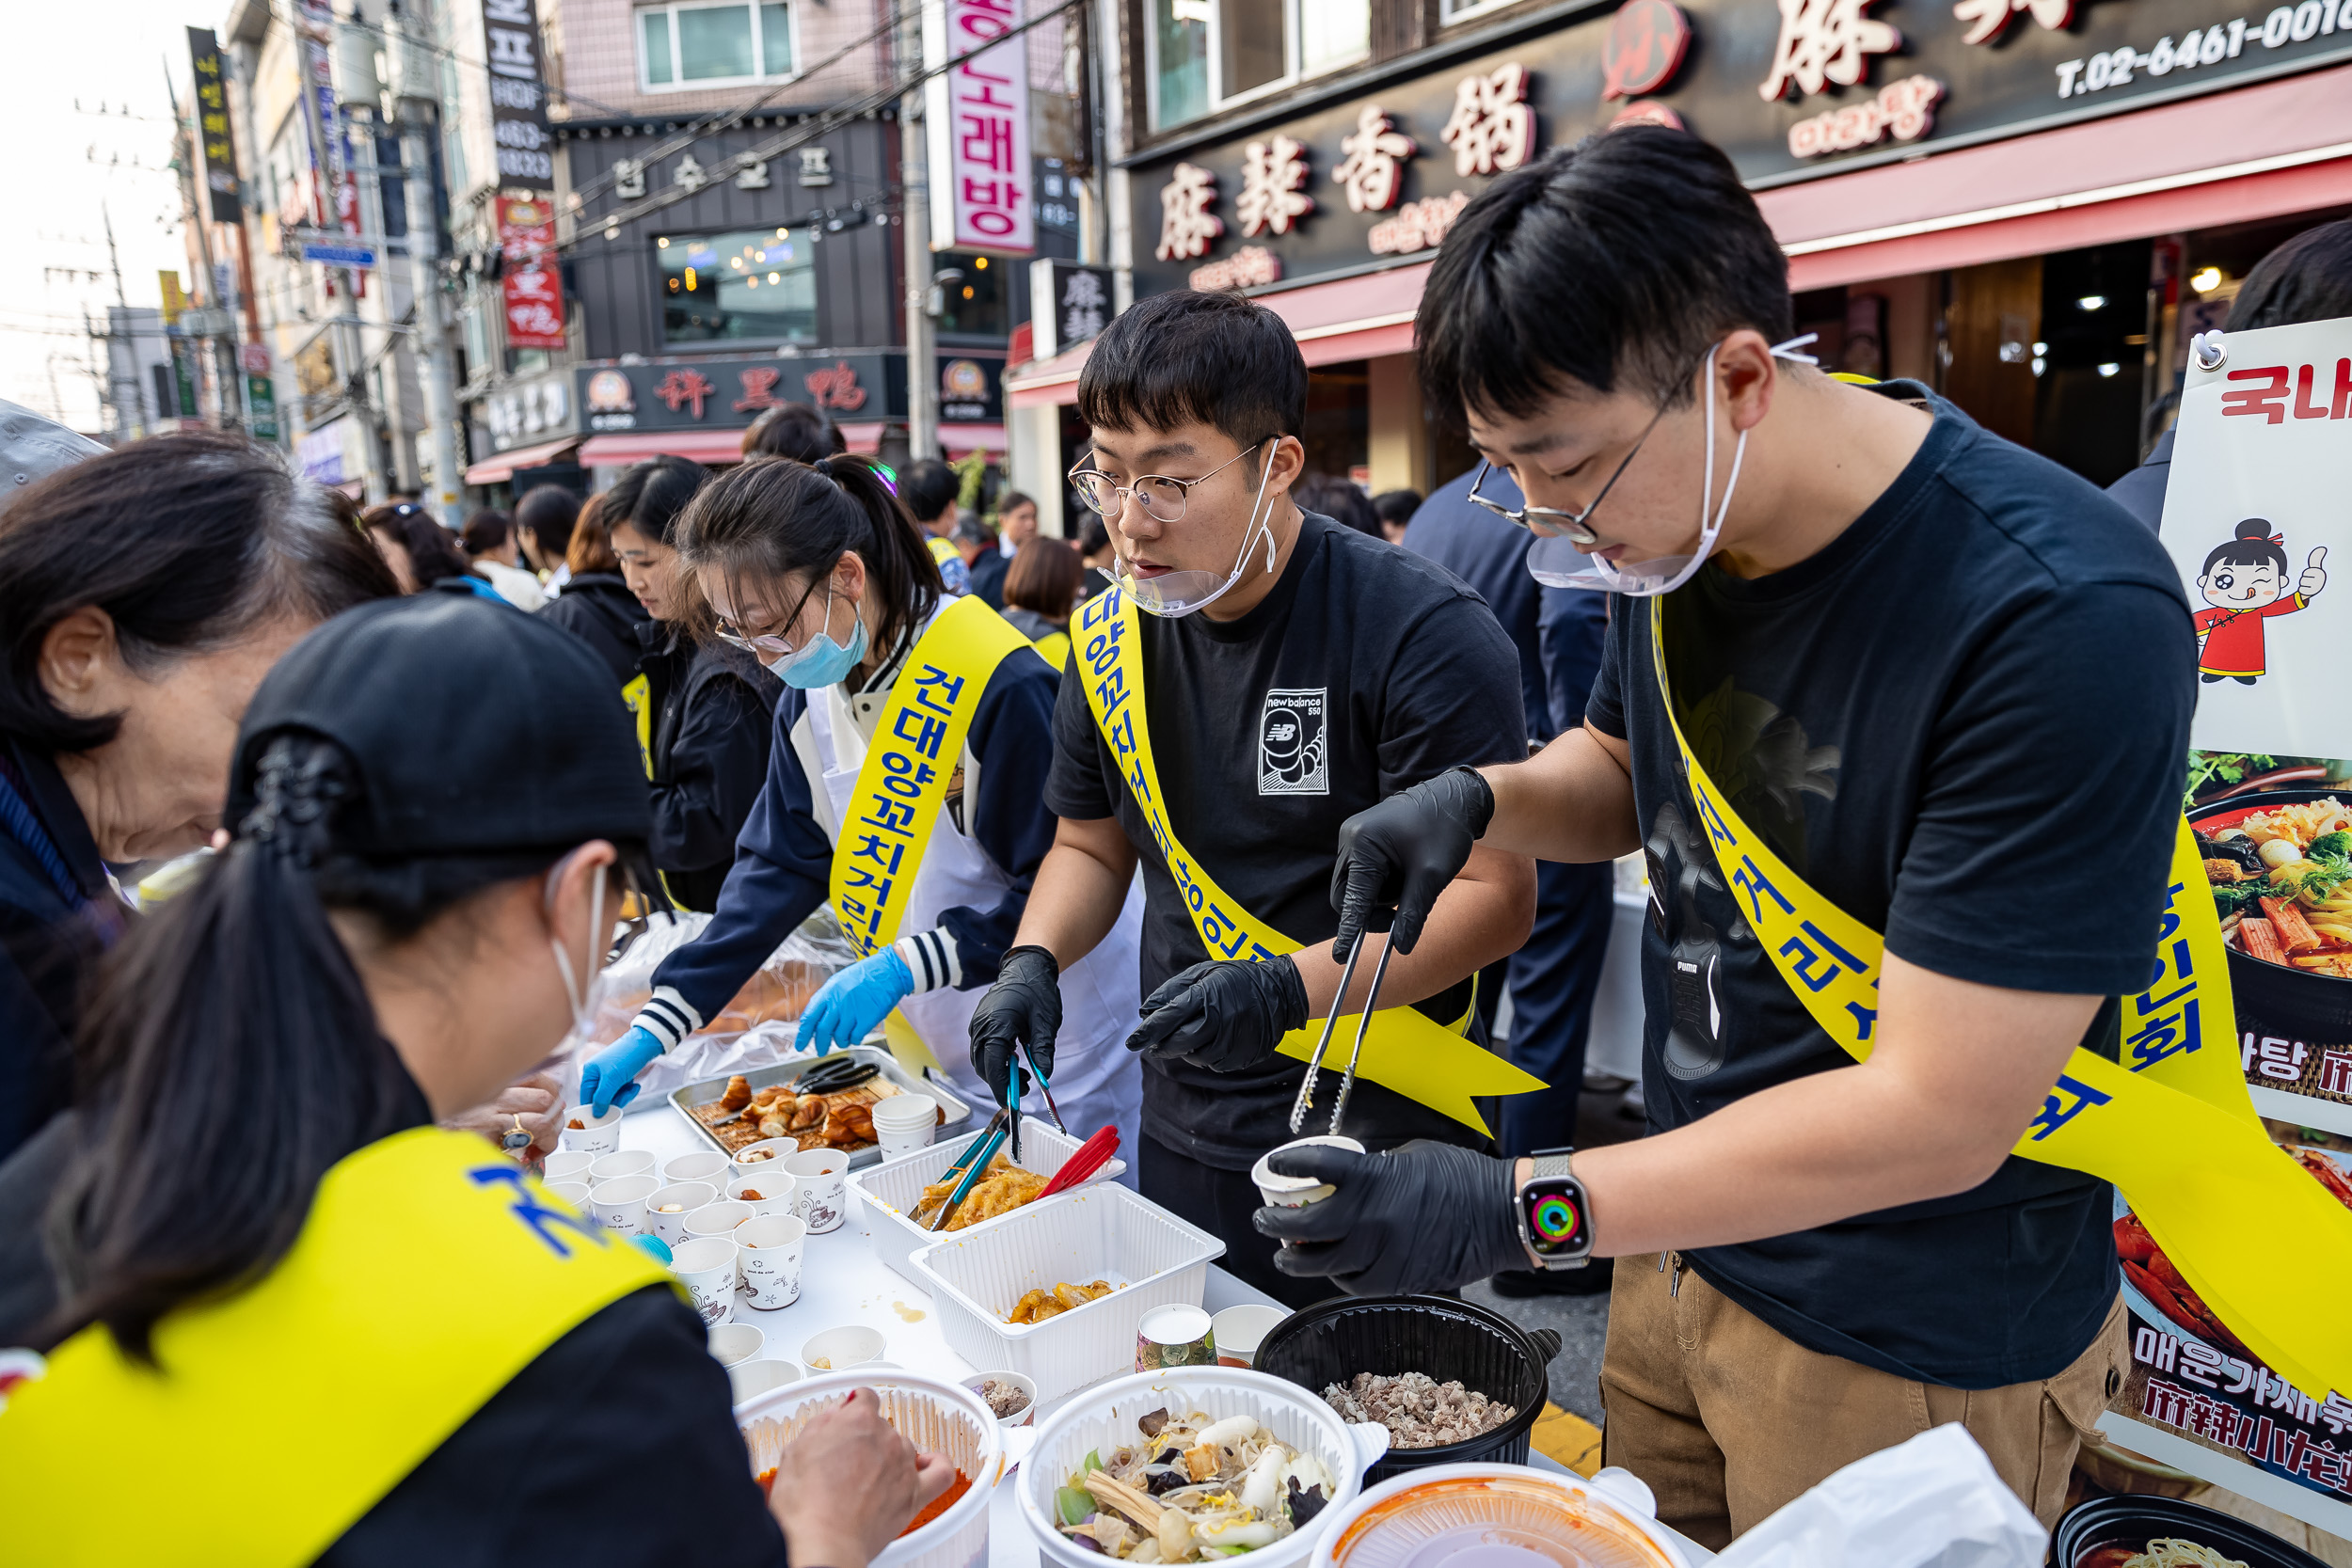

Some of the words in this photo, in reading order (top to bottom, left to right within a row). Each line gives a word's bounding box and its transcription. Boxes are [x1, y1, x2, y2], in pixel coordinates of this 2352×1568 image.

[1788, 74, 1944, 158] 마라탕
[1267, 698, 1287, 707] new
[1288, 696, 1321, 708] balance
[1308, 707, 1321, 716] 550
[1677, 960, 1698, 974] PUMA
